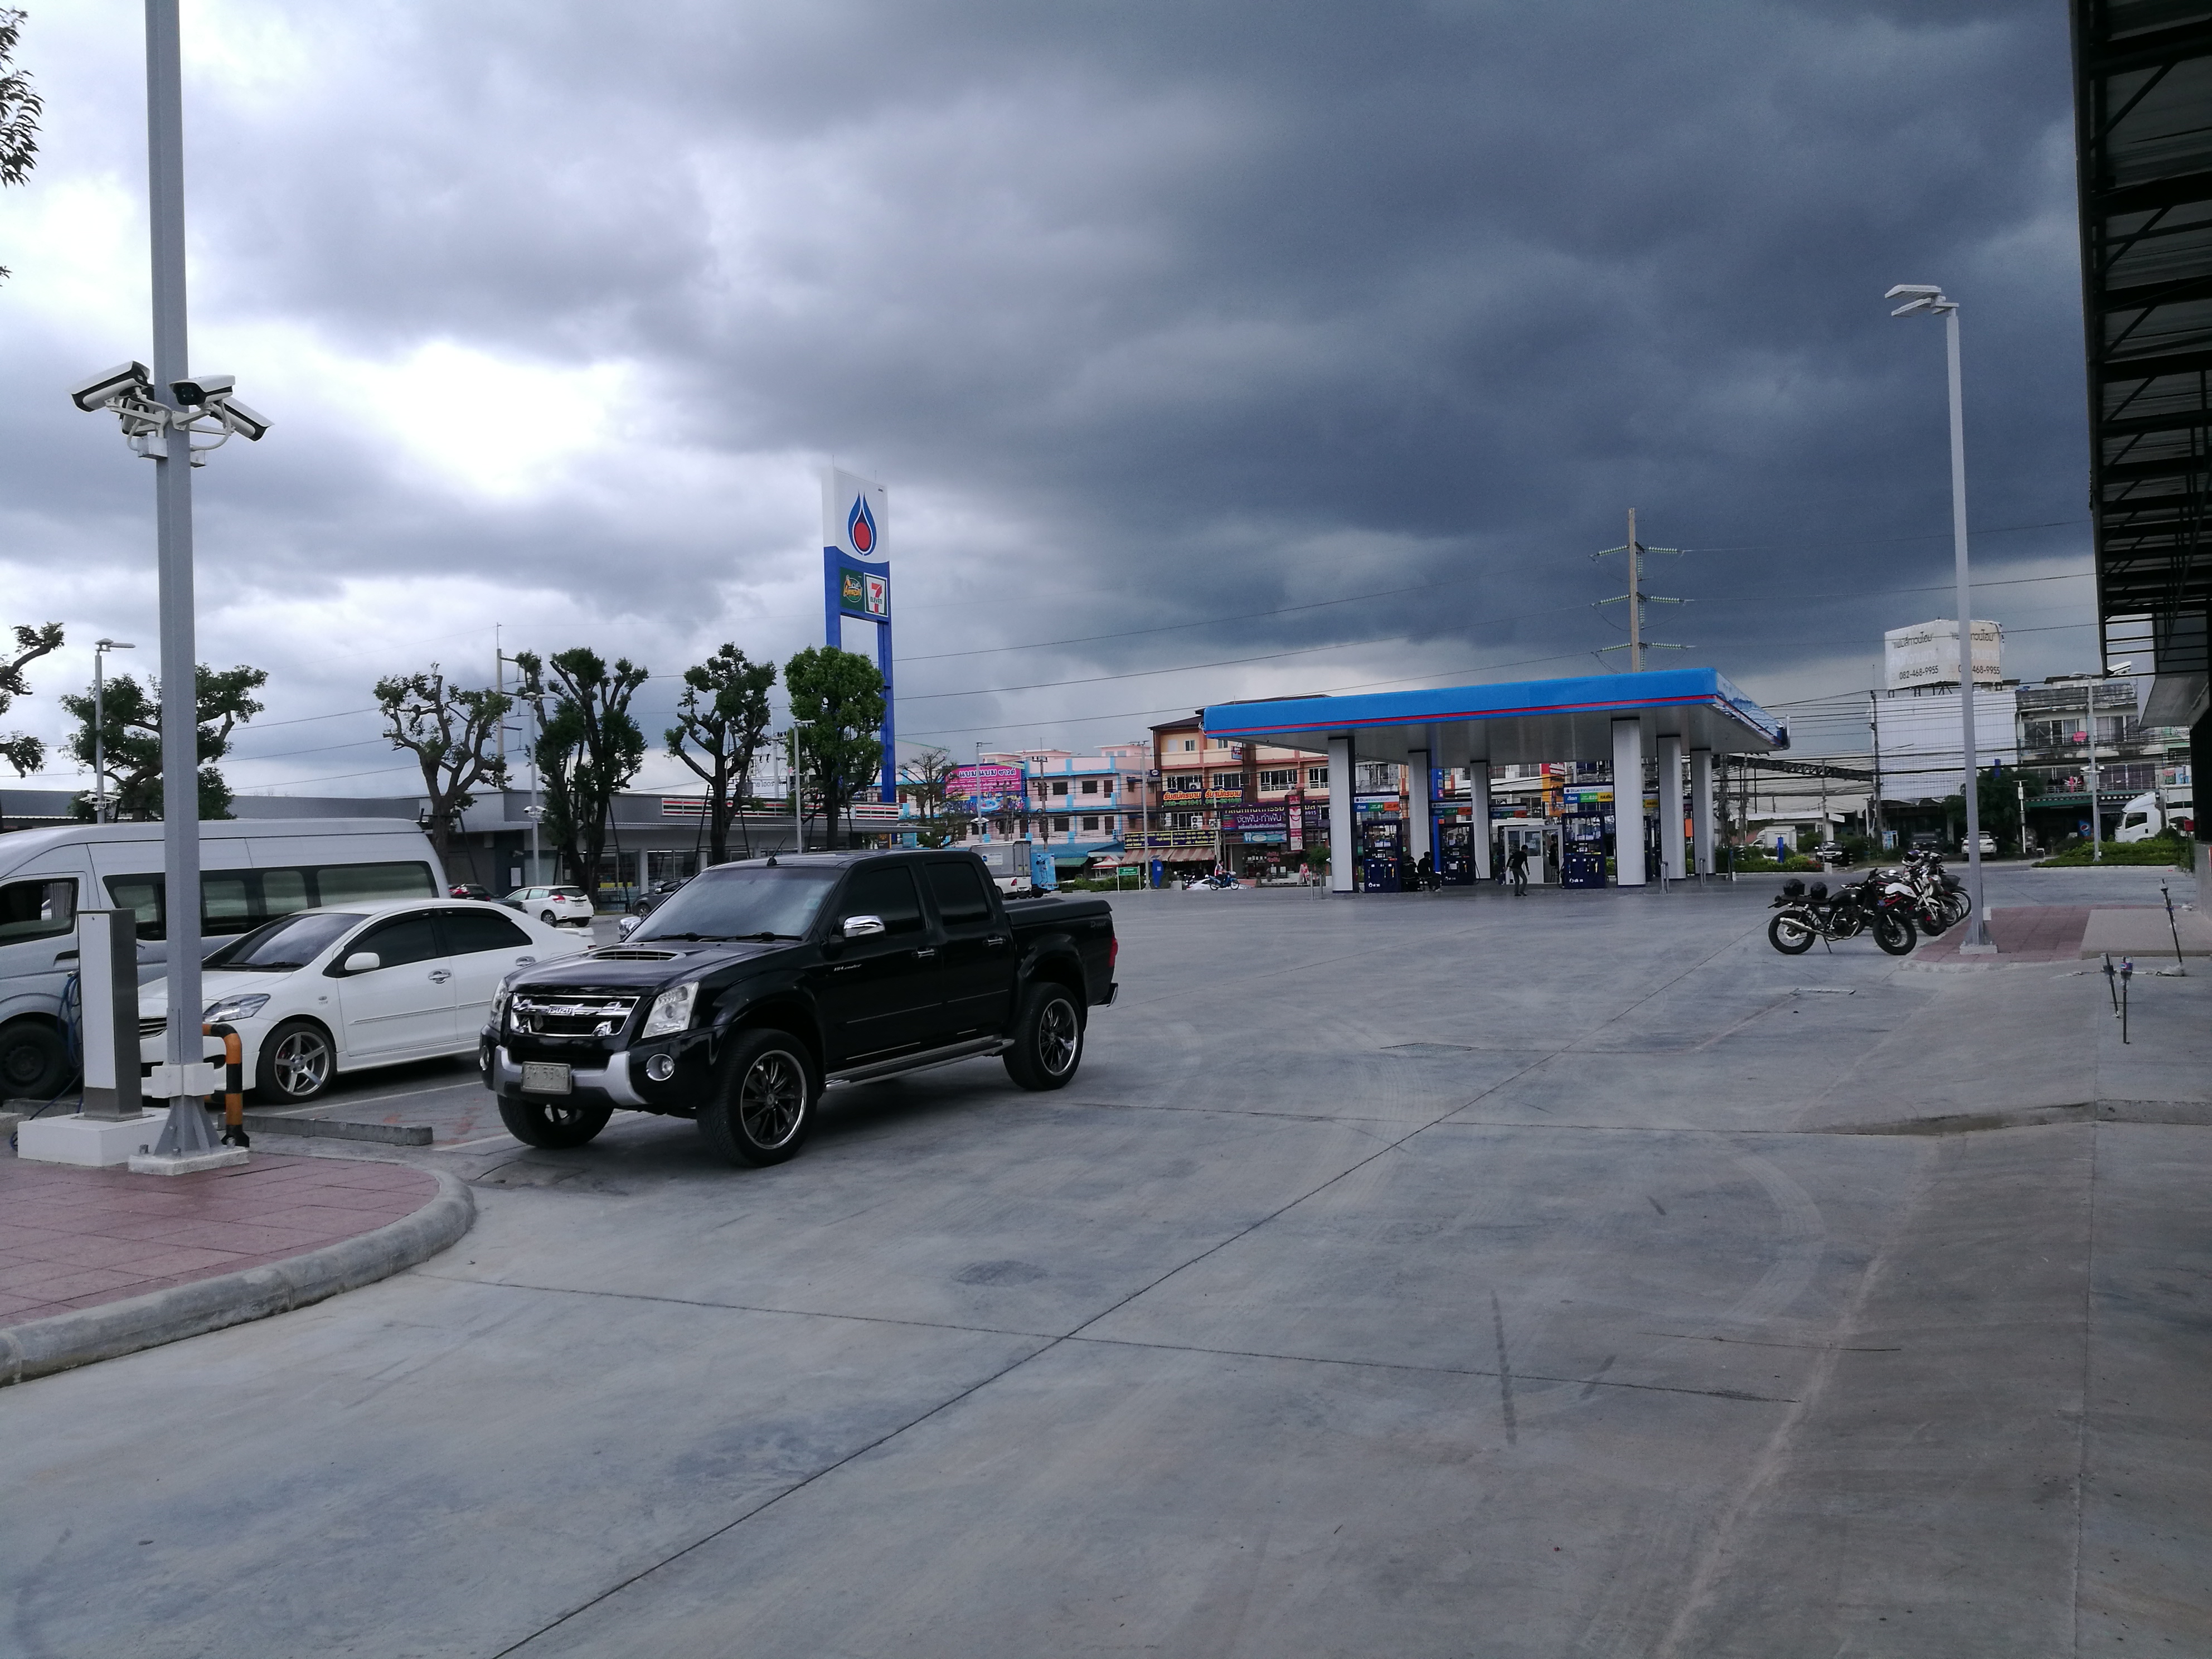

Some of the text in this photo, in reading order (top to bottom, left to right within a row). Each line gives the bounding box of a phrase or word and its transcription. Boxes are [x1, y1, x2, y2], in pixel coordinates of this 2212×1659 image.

[871, 583, 882, 613] 7
[1899, 665, 1938, 680] 082-468-9955
[1163, 791, 1202, 801] รับสมัครงาน
[1205, 789, 1242, 798] รับสมัครงาน
